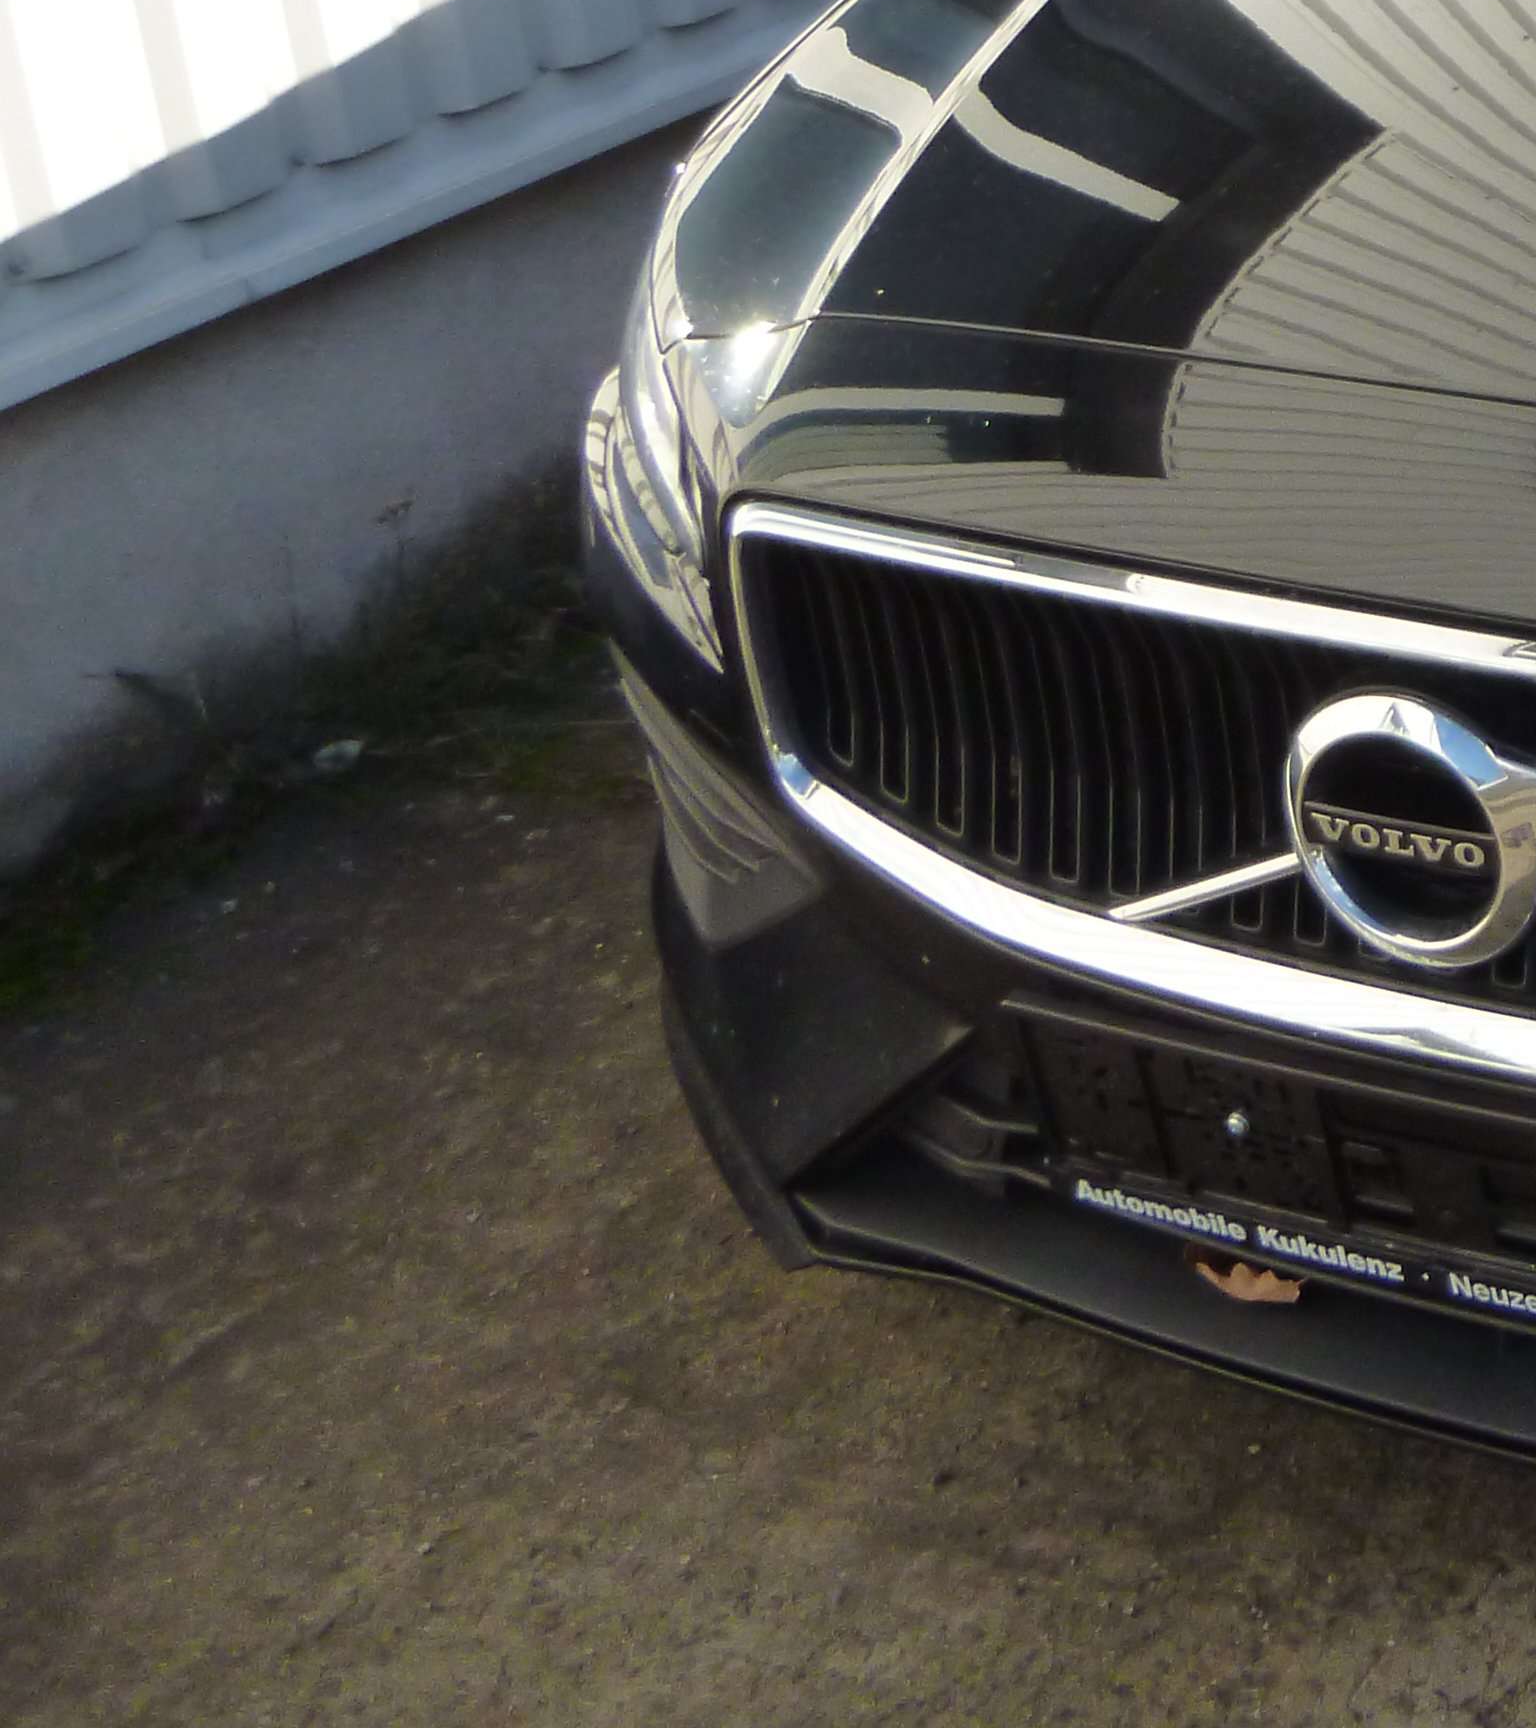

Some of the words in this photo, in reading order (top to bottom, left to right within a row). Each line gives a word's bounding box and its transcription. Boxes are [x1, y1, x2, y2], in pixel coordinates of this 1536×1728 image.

[1311, 812, 1486, 869] VOLVO
[1076, 1179, 1249, 1242] Automobile
[1257, 1225, 1405, 1282] Kukulenz
